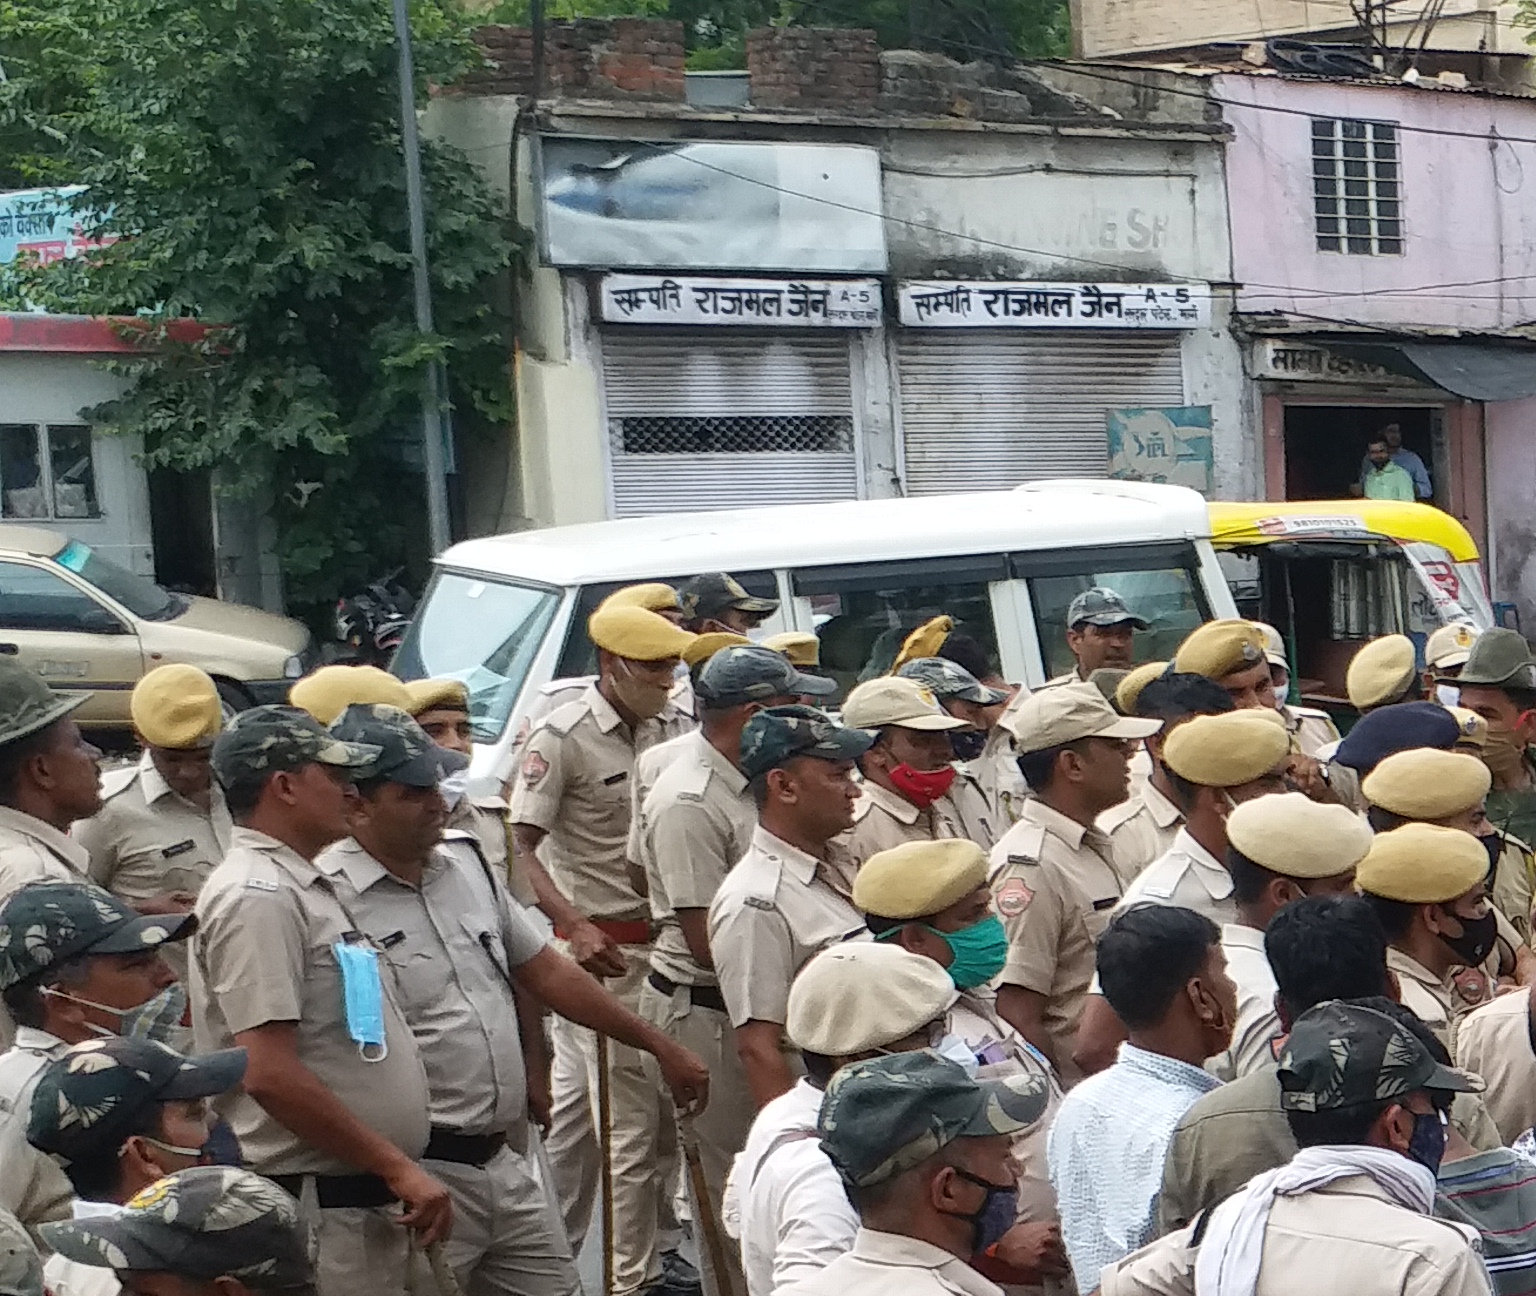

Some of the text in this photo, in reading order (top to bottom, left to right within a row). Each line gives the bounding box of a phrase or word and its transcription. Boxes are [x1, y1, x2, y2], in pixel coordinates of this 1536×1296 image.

[692, 286, 785, 317] राजमल
[787, 283, 831, 318] जैन
[840, 290, 871, 303] A-5
[978, 288, 1076, 318] राजमल
[1079, 285, 1126, 319] जैन
